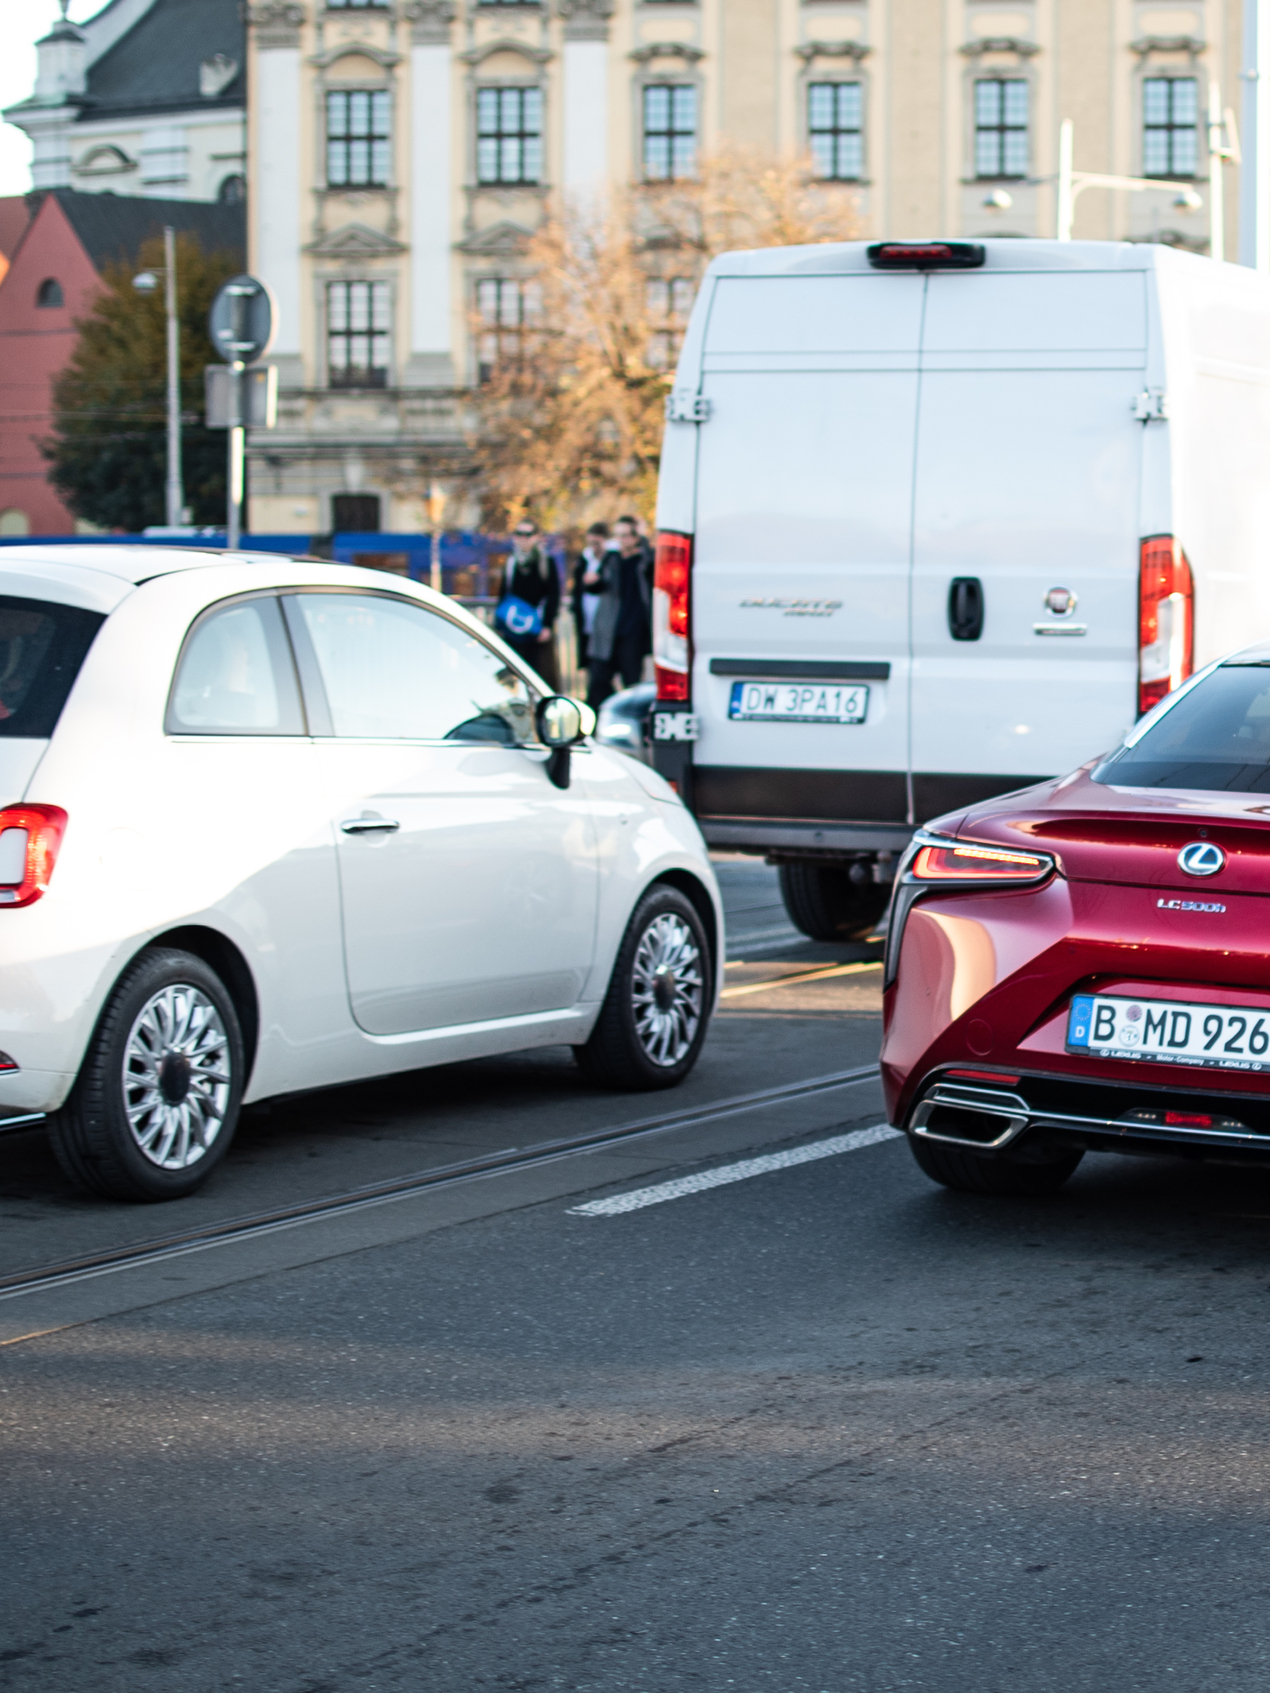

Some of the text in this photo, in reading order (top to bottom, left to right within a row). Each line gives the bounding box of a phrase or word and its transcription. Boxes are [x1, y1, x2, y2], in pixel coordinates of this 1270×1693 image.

[746, 687, 859, 714] DW 3PA16
[1074, 1026, 1085, 1038] D
[1093, 1004, 1117, 1042] B
[1142, 1008, 1192, 1049] MD
[1110, 1050, 1142, 1060] LEXUS
[1218, 1060, 1250, 1070] LEXUS
